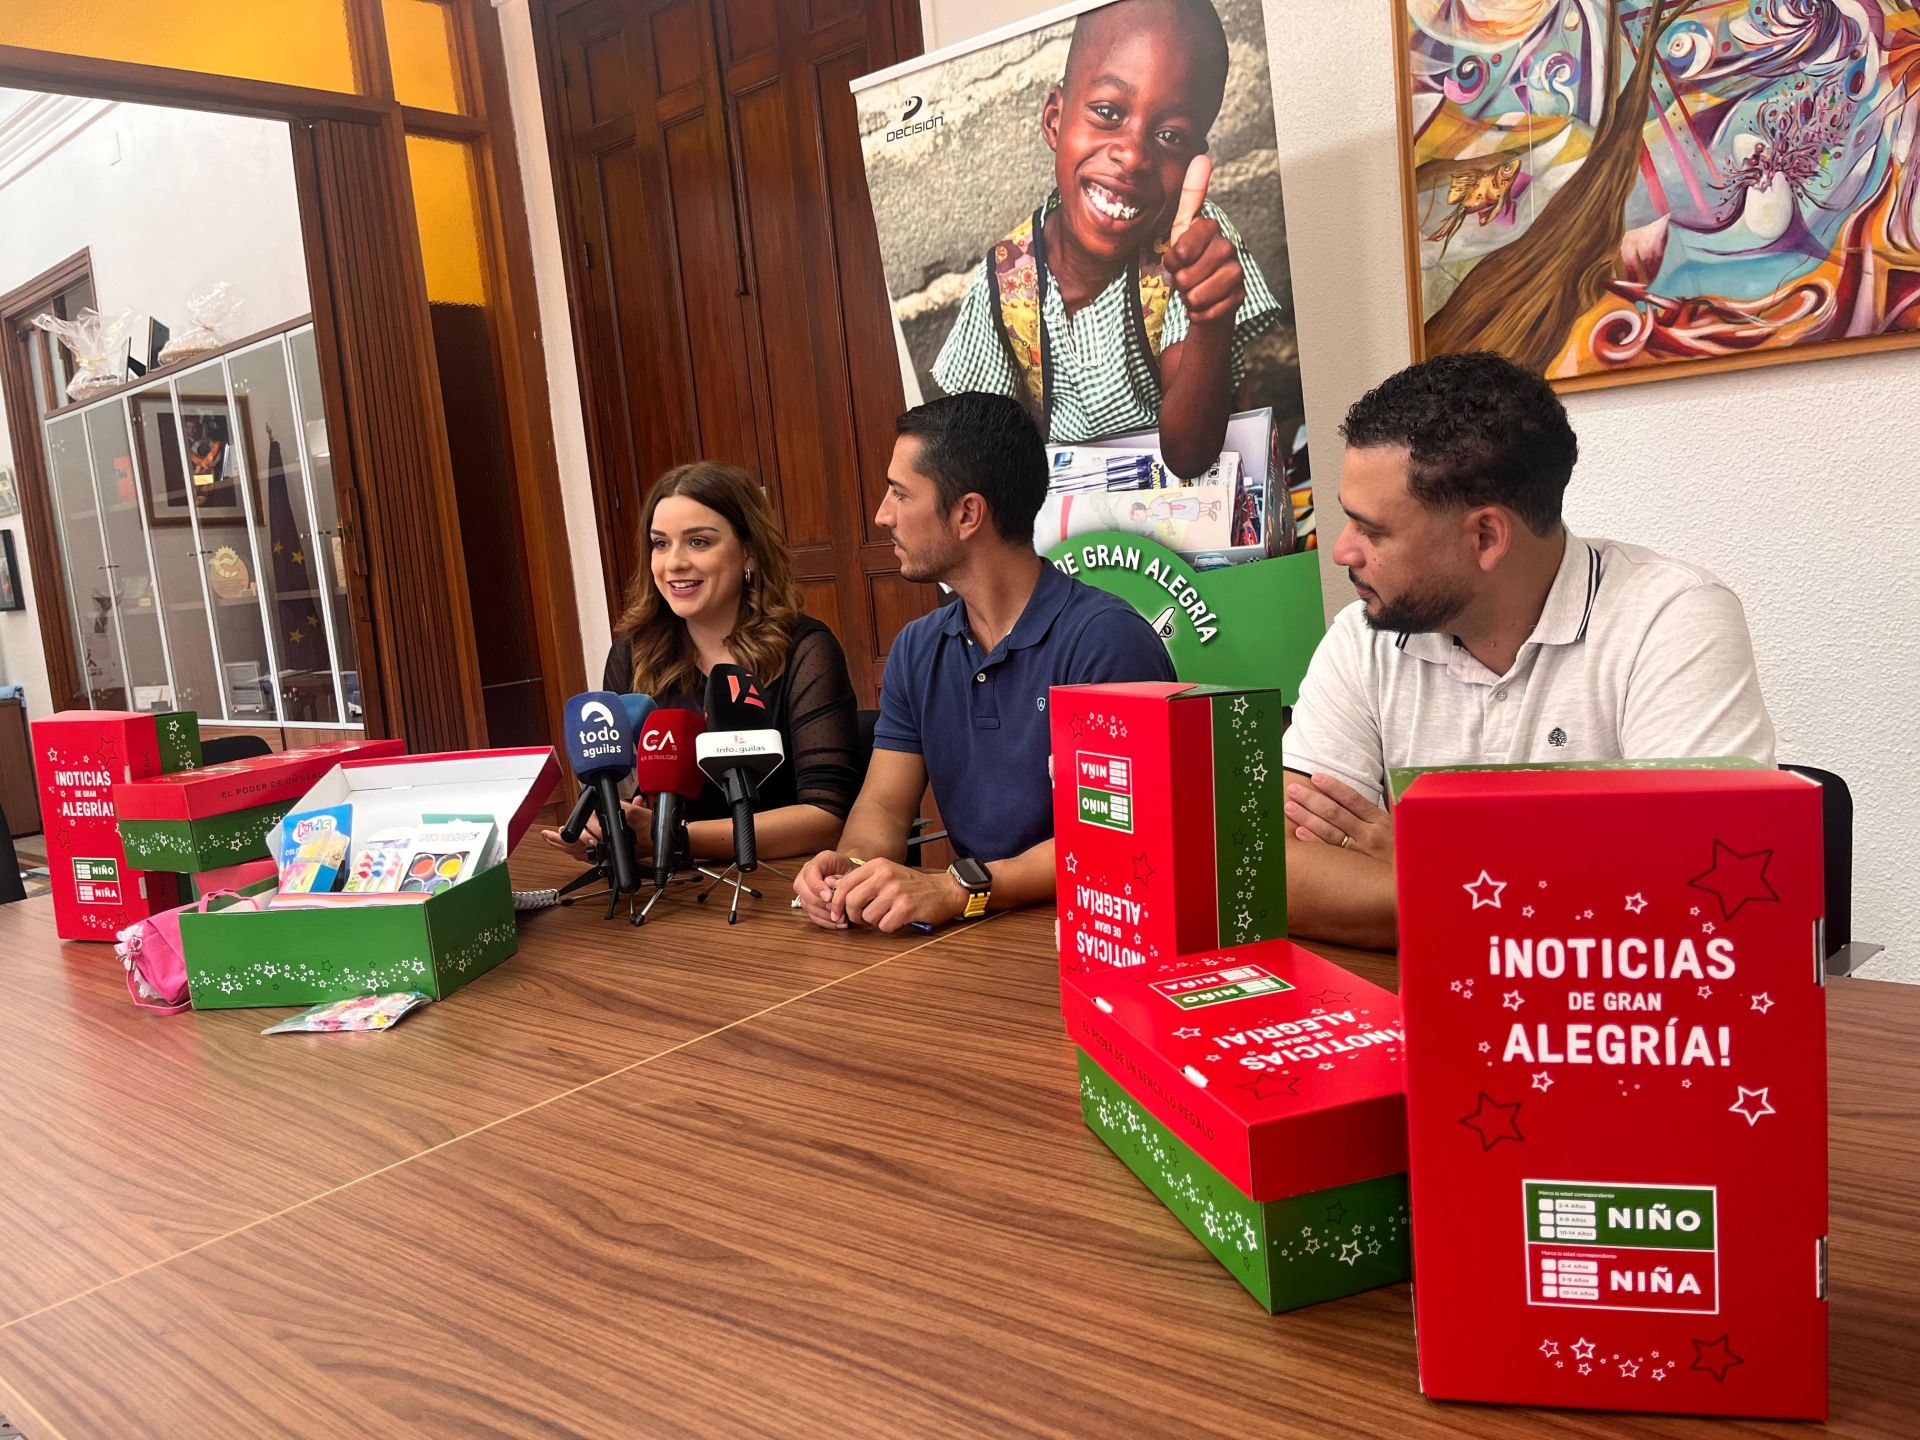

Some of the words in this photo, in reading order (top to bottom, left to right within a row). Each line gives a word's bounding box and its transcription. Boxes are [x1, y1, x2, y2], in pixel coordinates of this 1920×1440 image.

[1082, 544, 1141, 571] GRAN
[1144, 557, 1219, 644] ALEGRÍA
[579, 725, 620, 745] todo
[582, 743, 622, 759] aguilas
[55, 770, 112, 786] ¡NOTICIAS
[1081, 762, 1108, 780] NIÑA
[75, 790, 82, 798] DE
[83, 790, 97, 798] GRAN
[221, 791, 233, 799] EL
[236, 784, 267, 796] PODER
[271, 780, 282, 788] DE
[285, 777, 299, 786] UN
[63, 799, 115, 817] ALEGRÍA!
[1082, 797, 1109, 815] NIÑO
[91, 864, 115, 876] NIÑO
[95, 887, 118, 898] NIÑA
[1076, 884, 1141, 926] ALEGRÍA!
[1094, 919, 1112, 935] GRAN
[1112, 926, 1122, 938] DE
[1489, 936, 1736, 980] ¡NOTICIAS
[1163, 976, 1219, 991] NIÑA
[1183, 988, 1239, 1003] NIÑO
[1568, 992, 1596, 1011] DE
[1603, 992, 1662, 1012] GRAN
[1212, 1010, 1357, 1049] ALEGRÍA!
[1311, 1030, 1335, 1040] DE
[1271, 1034, 1313, 1048] GRAN
[1502, 1017, 1731, 1067] ALEGRÍA!
[1082, 1020, 1091, 1036] EL
[1091, 1028, 1113, 1054] PODER
[1115, 1046, 1125, 1060] DE
[1126, 1060, 1136, 1074] UN
[1139, 1070, 1176, 1109] SENCILLO
[1179, 1103, 1215, 1141] REGALO
[1608, 1203, 1701, 1232] NIÑO
[1610, 1266, 1702, 1295] NIÑA
